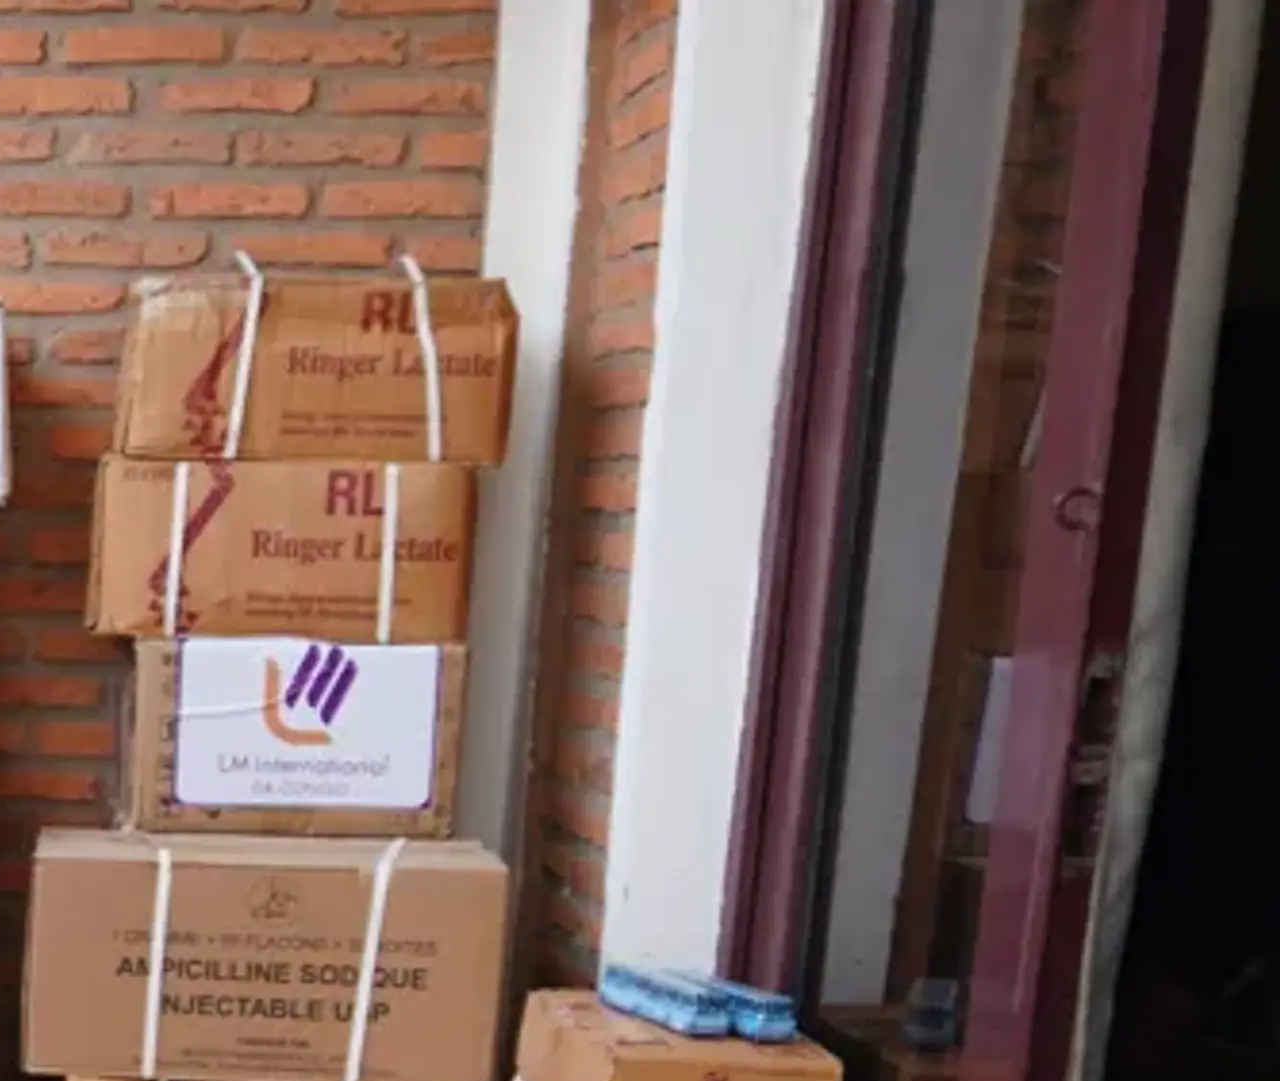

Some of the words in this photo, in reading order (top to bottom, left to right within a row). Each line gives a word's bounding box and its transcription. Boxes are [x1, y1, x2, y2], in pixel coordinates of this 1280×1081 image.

[286, 345, 381, 380] Ringer
[392, 349, 498, 380] Latate
[323, 468, 386, 517] RL
[250, 529, 346, 565] Ringer
[354, 532, 459, 563] Lctate
[216, 753, 251, 775] LM
[255, 753, 391, 778] International
[299, 963, 430, 992] SODQUE
[160, 994, 325, 1023] NJECTABLE
[334, 1000, 391, 1025] UP
